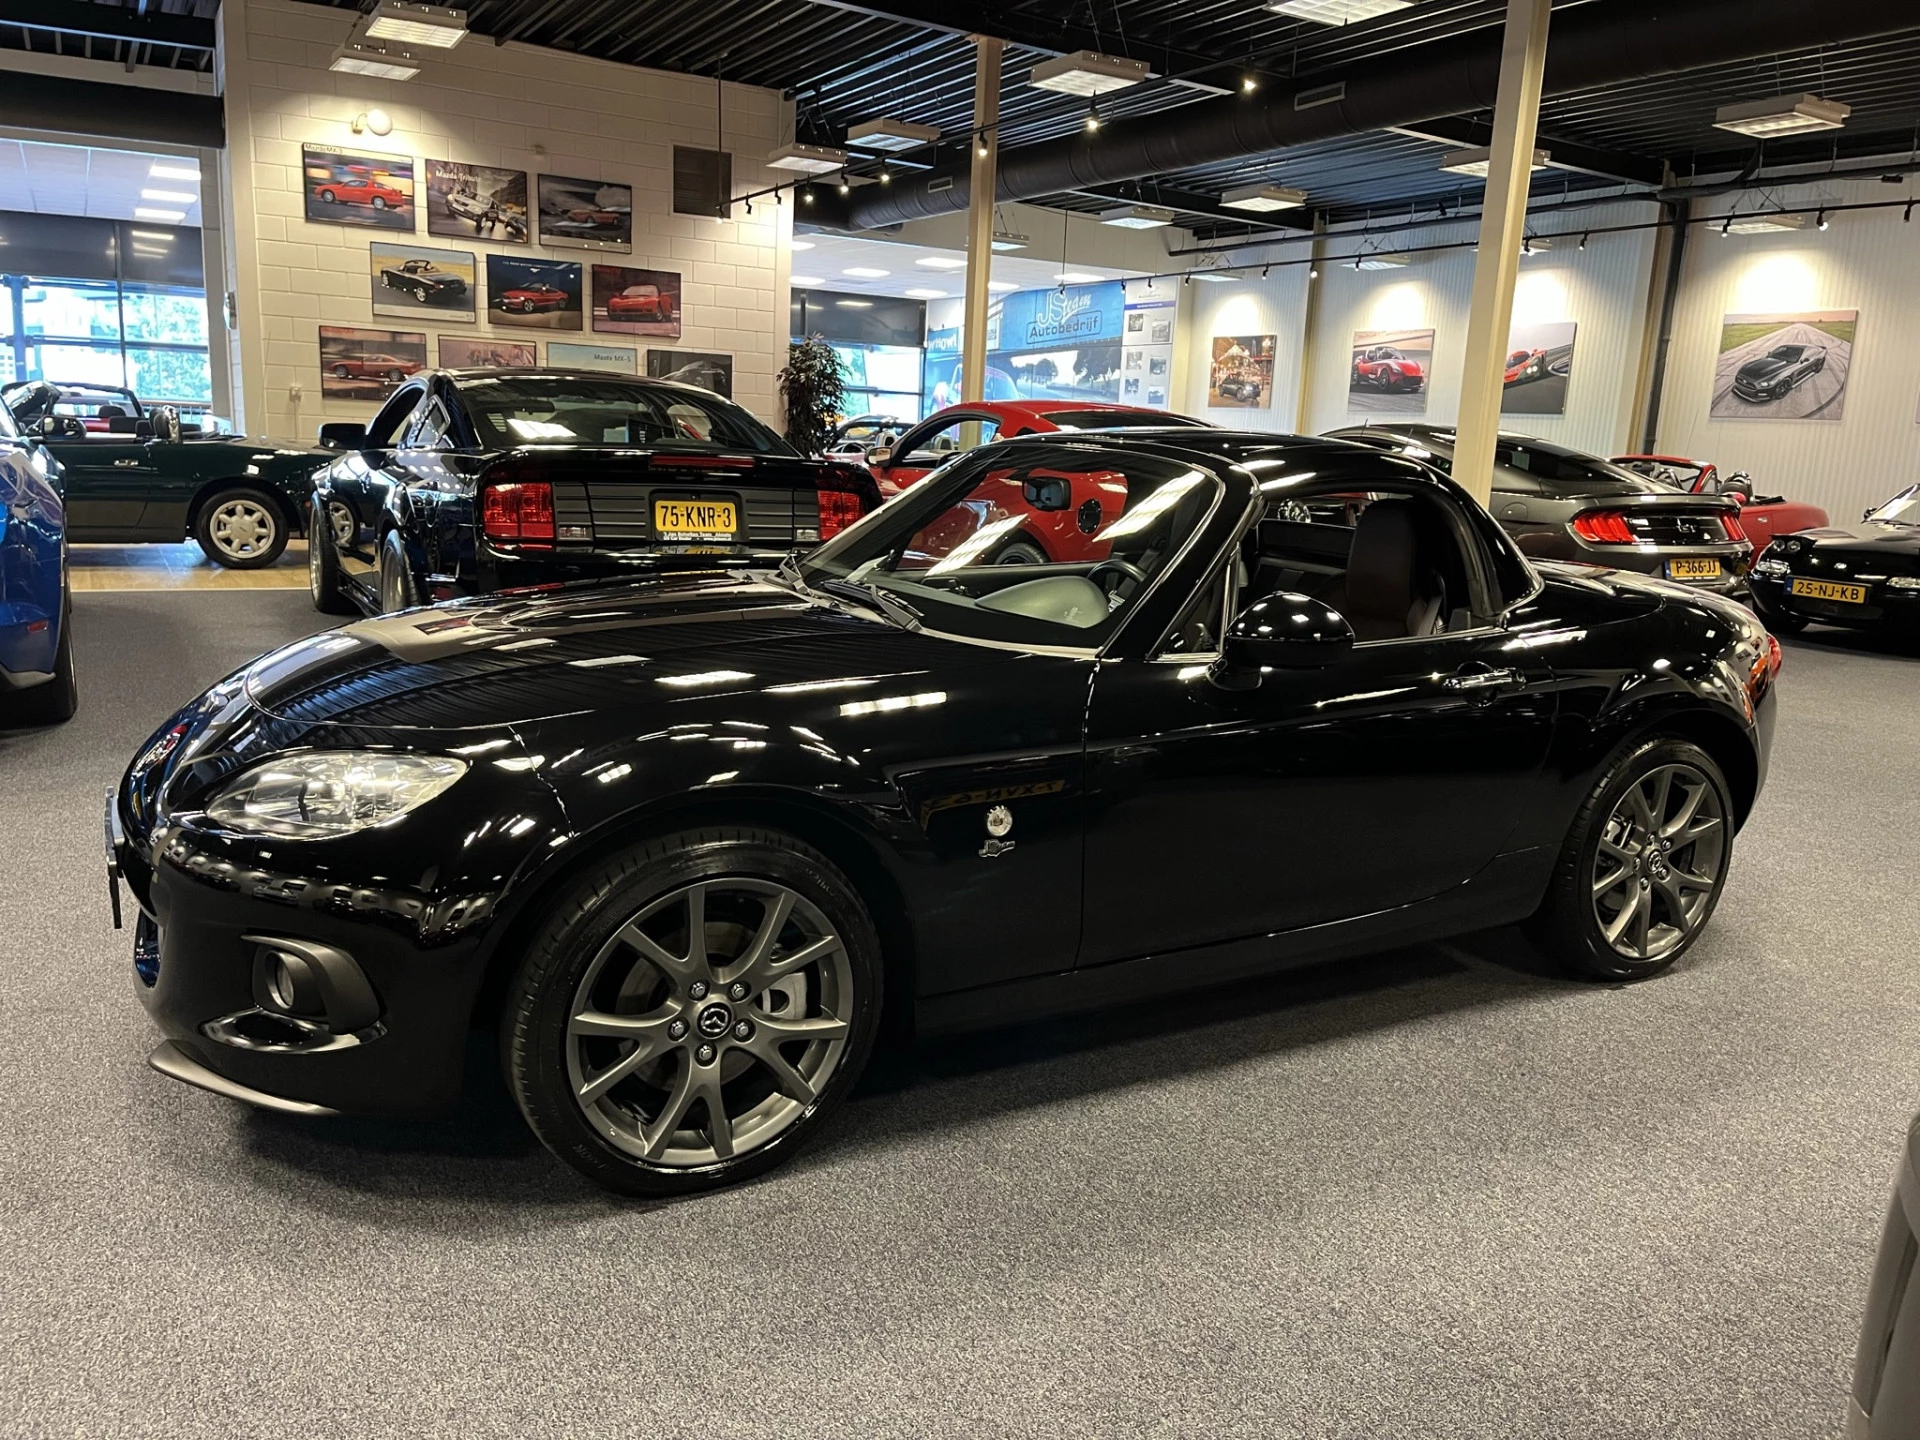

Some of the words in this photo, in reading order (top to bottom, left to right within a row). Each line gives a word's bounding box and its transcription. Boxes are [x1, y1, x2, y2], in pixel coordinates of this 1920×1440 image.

[435, 170, 458, 180] Mazda
[458, 172, 482, 182] Tribute
[1029, 316, 1099, 338] Autobedrijf
[593, 353, 613, 361] Mazda
[614, 354, 632, 362] MX-5
[660, 505, 731, 528] 75-KNR-3
[1675, 560, 1716, 574] P-366-JJ
[1796, 581, 1860, 601] 25-NJ-KB
